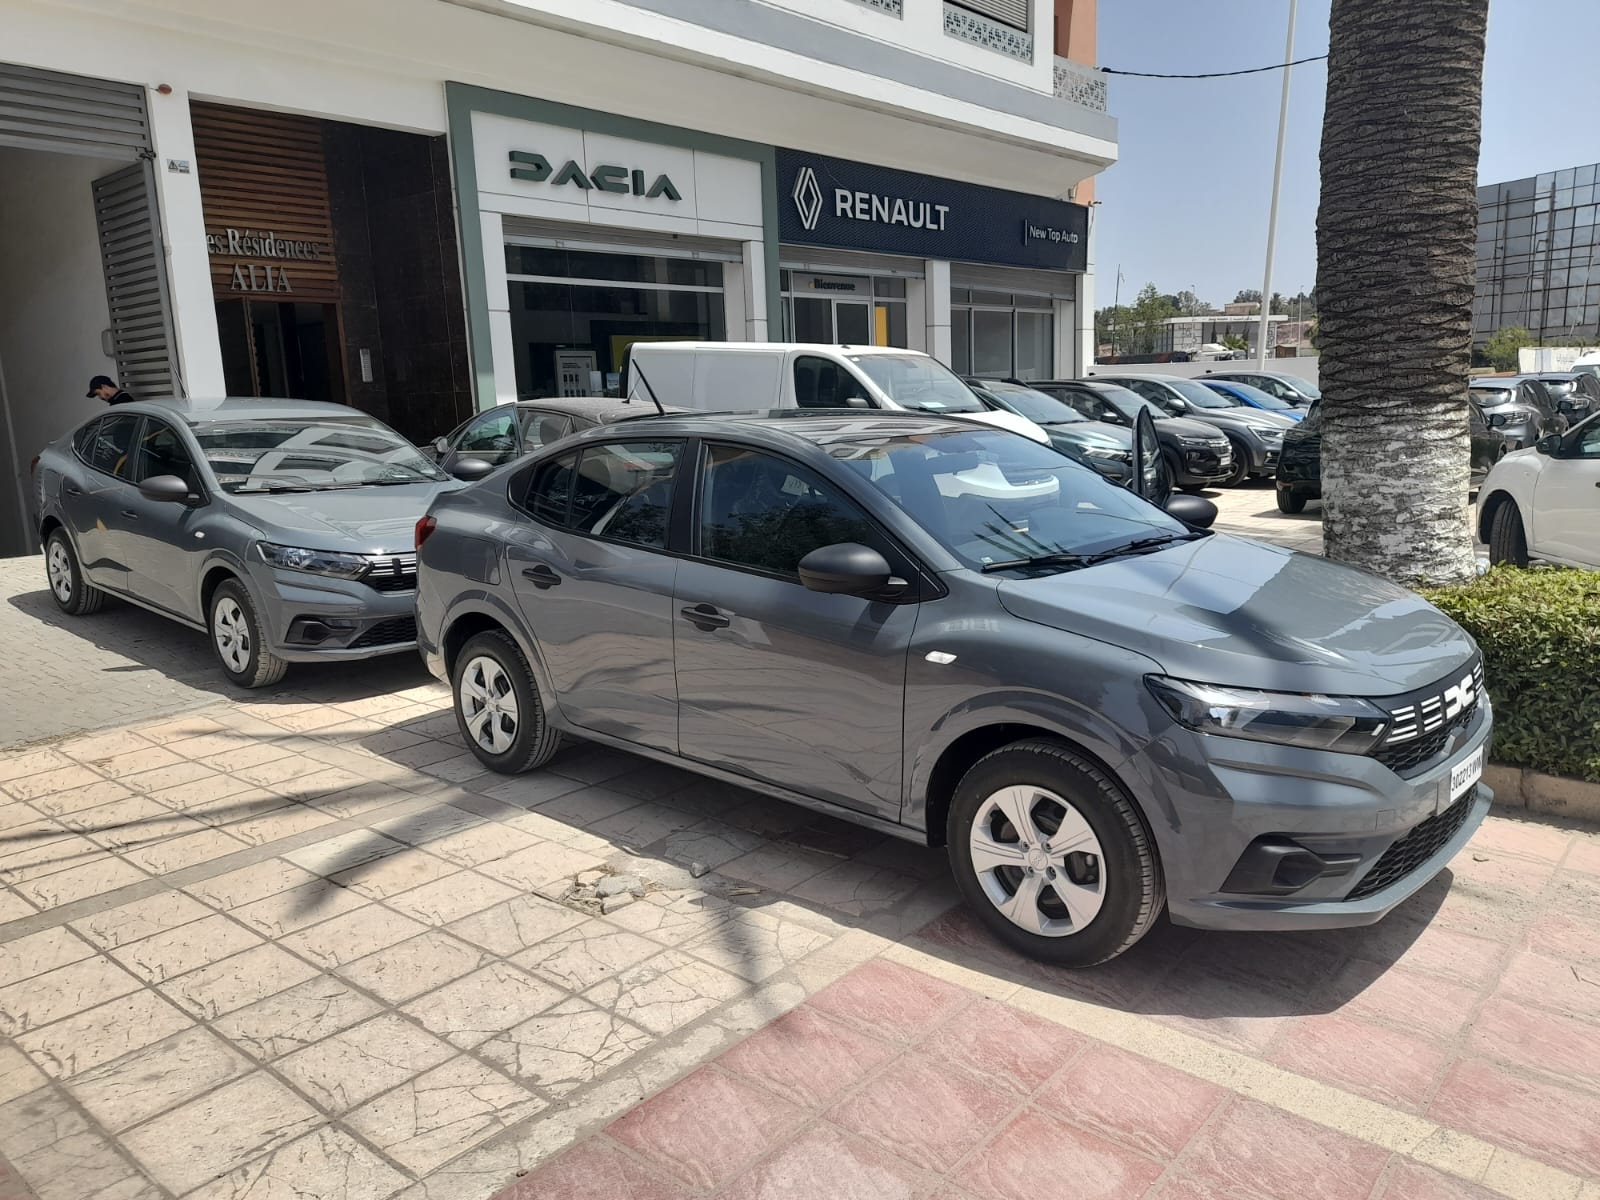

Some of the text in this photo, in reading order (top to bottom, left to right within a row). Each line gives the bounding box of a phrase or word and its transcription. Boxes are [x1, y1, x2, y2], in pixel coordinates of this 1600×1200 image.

[508, 150, 682, 201] DACIA
[834, 188, 949, 231] RENAULT
[206, 228, 321, 260] es Résidences
[1029, 224, 1079, 244] New Top Auto
[230, 263, 294, 293] ALIA
